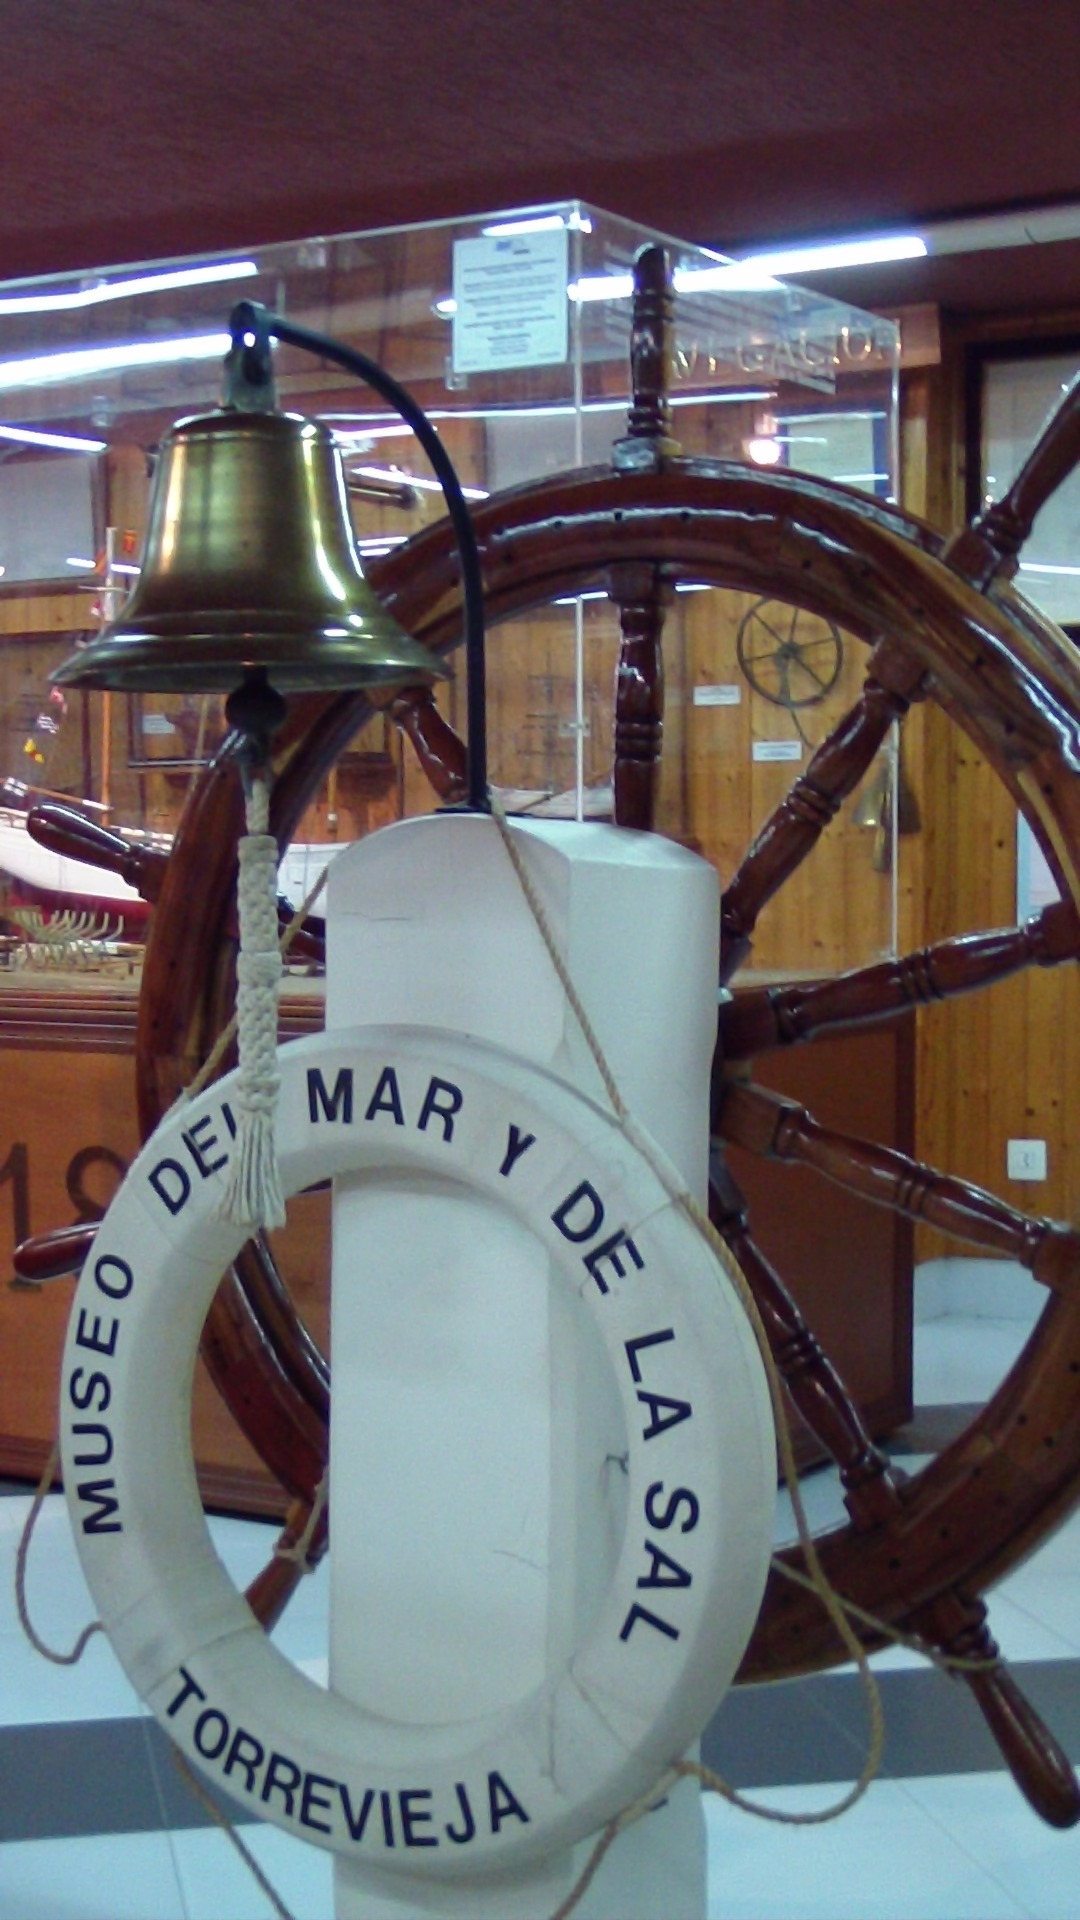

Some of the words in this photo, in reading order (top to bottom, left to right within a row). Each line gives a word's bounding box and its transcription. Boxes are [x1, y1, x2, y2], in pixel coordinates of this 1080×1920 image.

[306, 1066, 463, 1143] MAR
[499, 1123, 536, 1177] Y
[550, 1180, 645, 1295] DE
[69, 1254, 134, 1535] MUSEO
[624, 1328, 692, 1441] LA
[619, 1481, 700, 1643] SAL
[165, 1665, 532, 1849] TORREVIEJA
